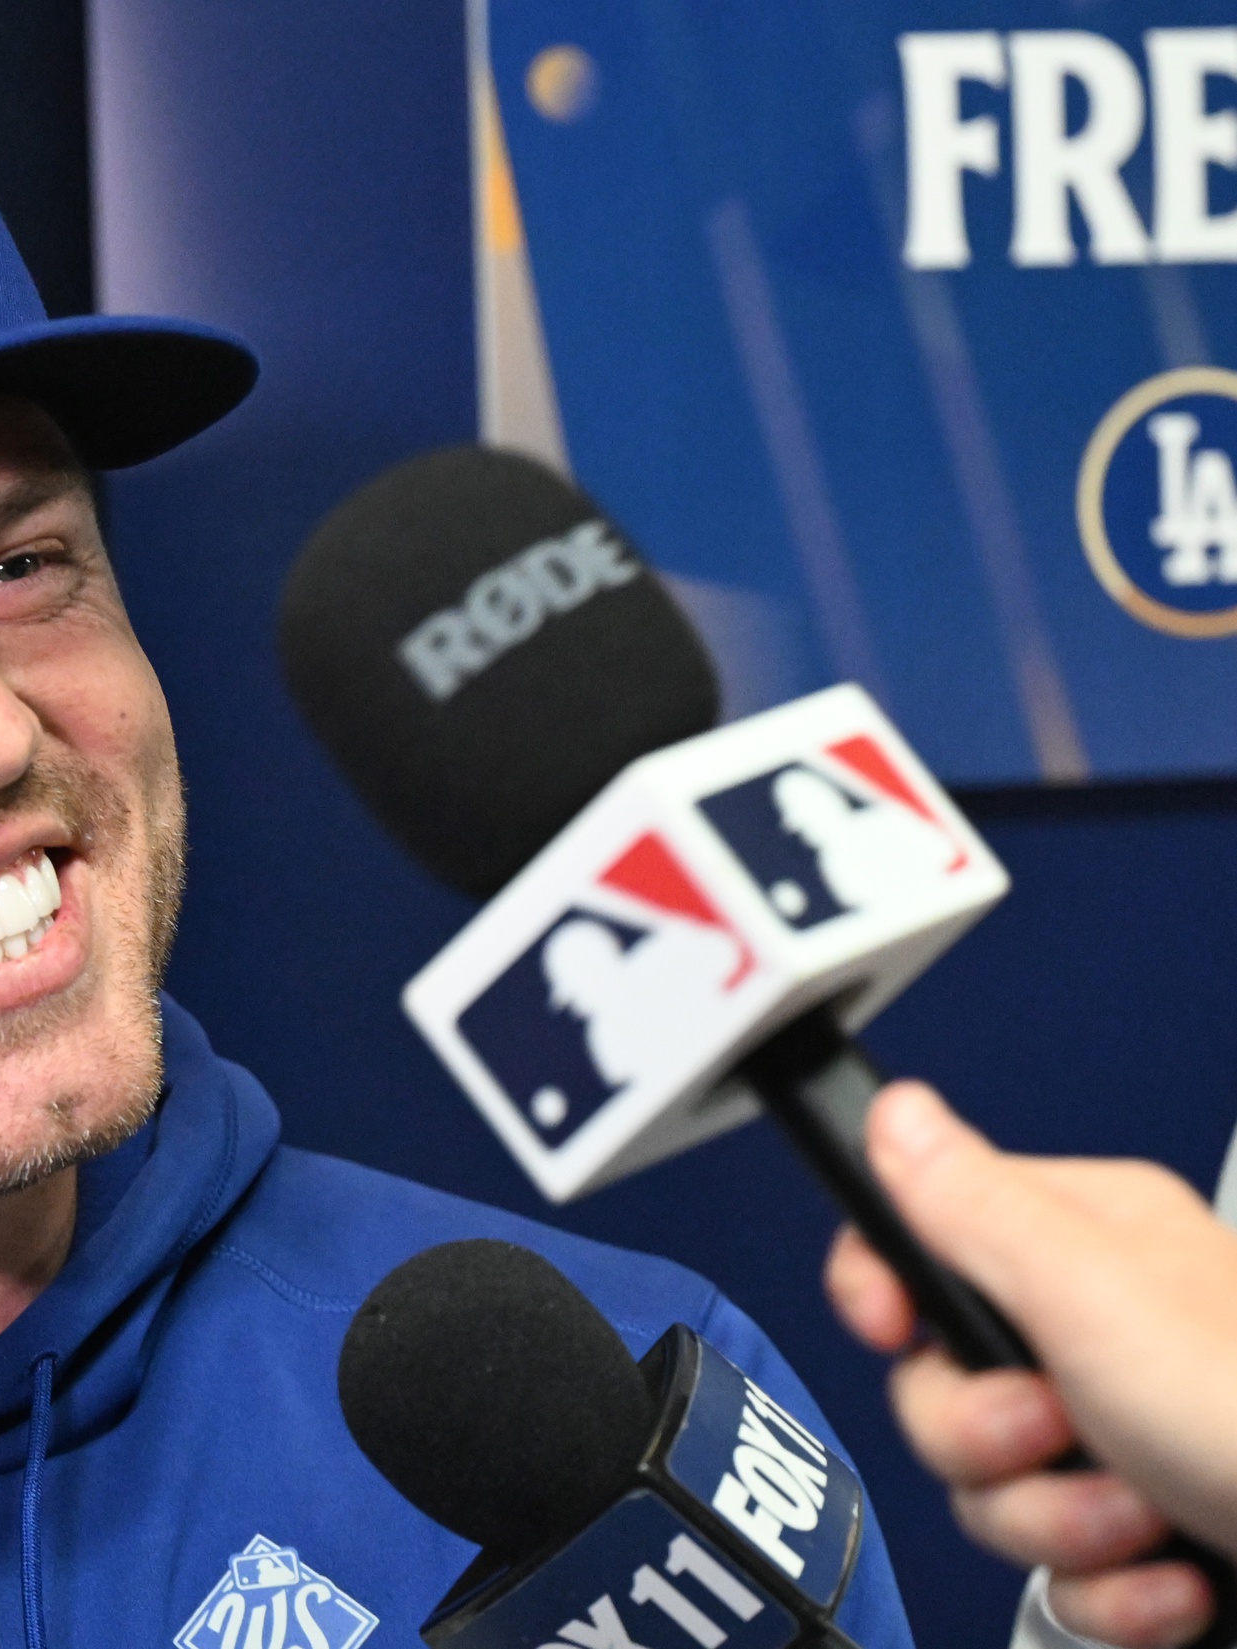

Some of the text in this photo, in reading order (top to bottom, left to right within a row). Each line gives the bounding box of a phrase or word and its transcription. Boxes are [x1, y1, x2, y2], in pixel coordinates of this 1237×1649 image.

[895, 25, 1237, 271] FRE
[1146, 411, 1237, 587] LA
[712, 1376, 827, 1580] FOX 11
[630, 1532, 765, 1649] 11
